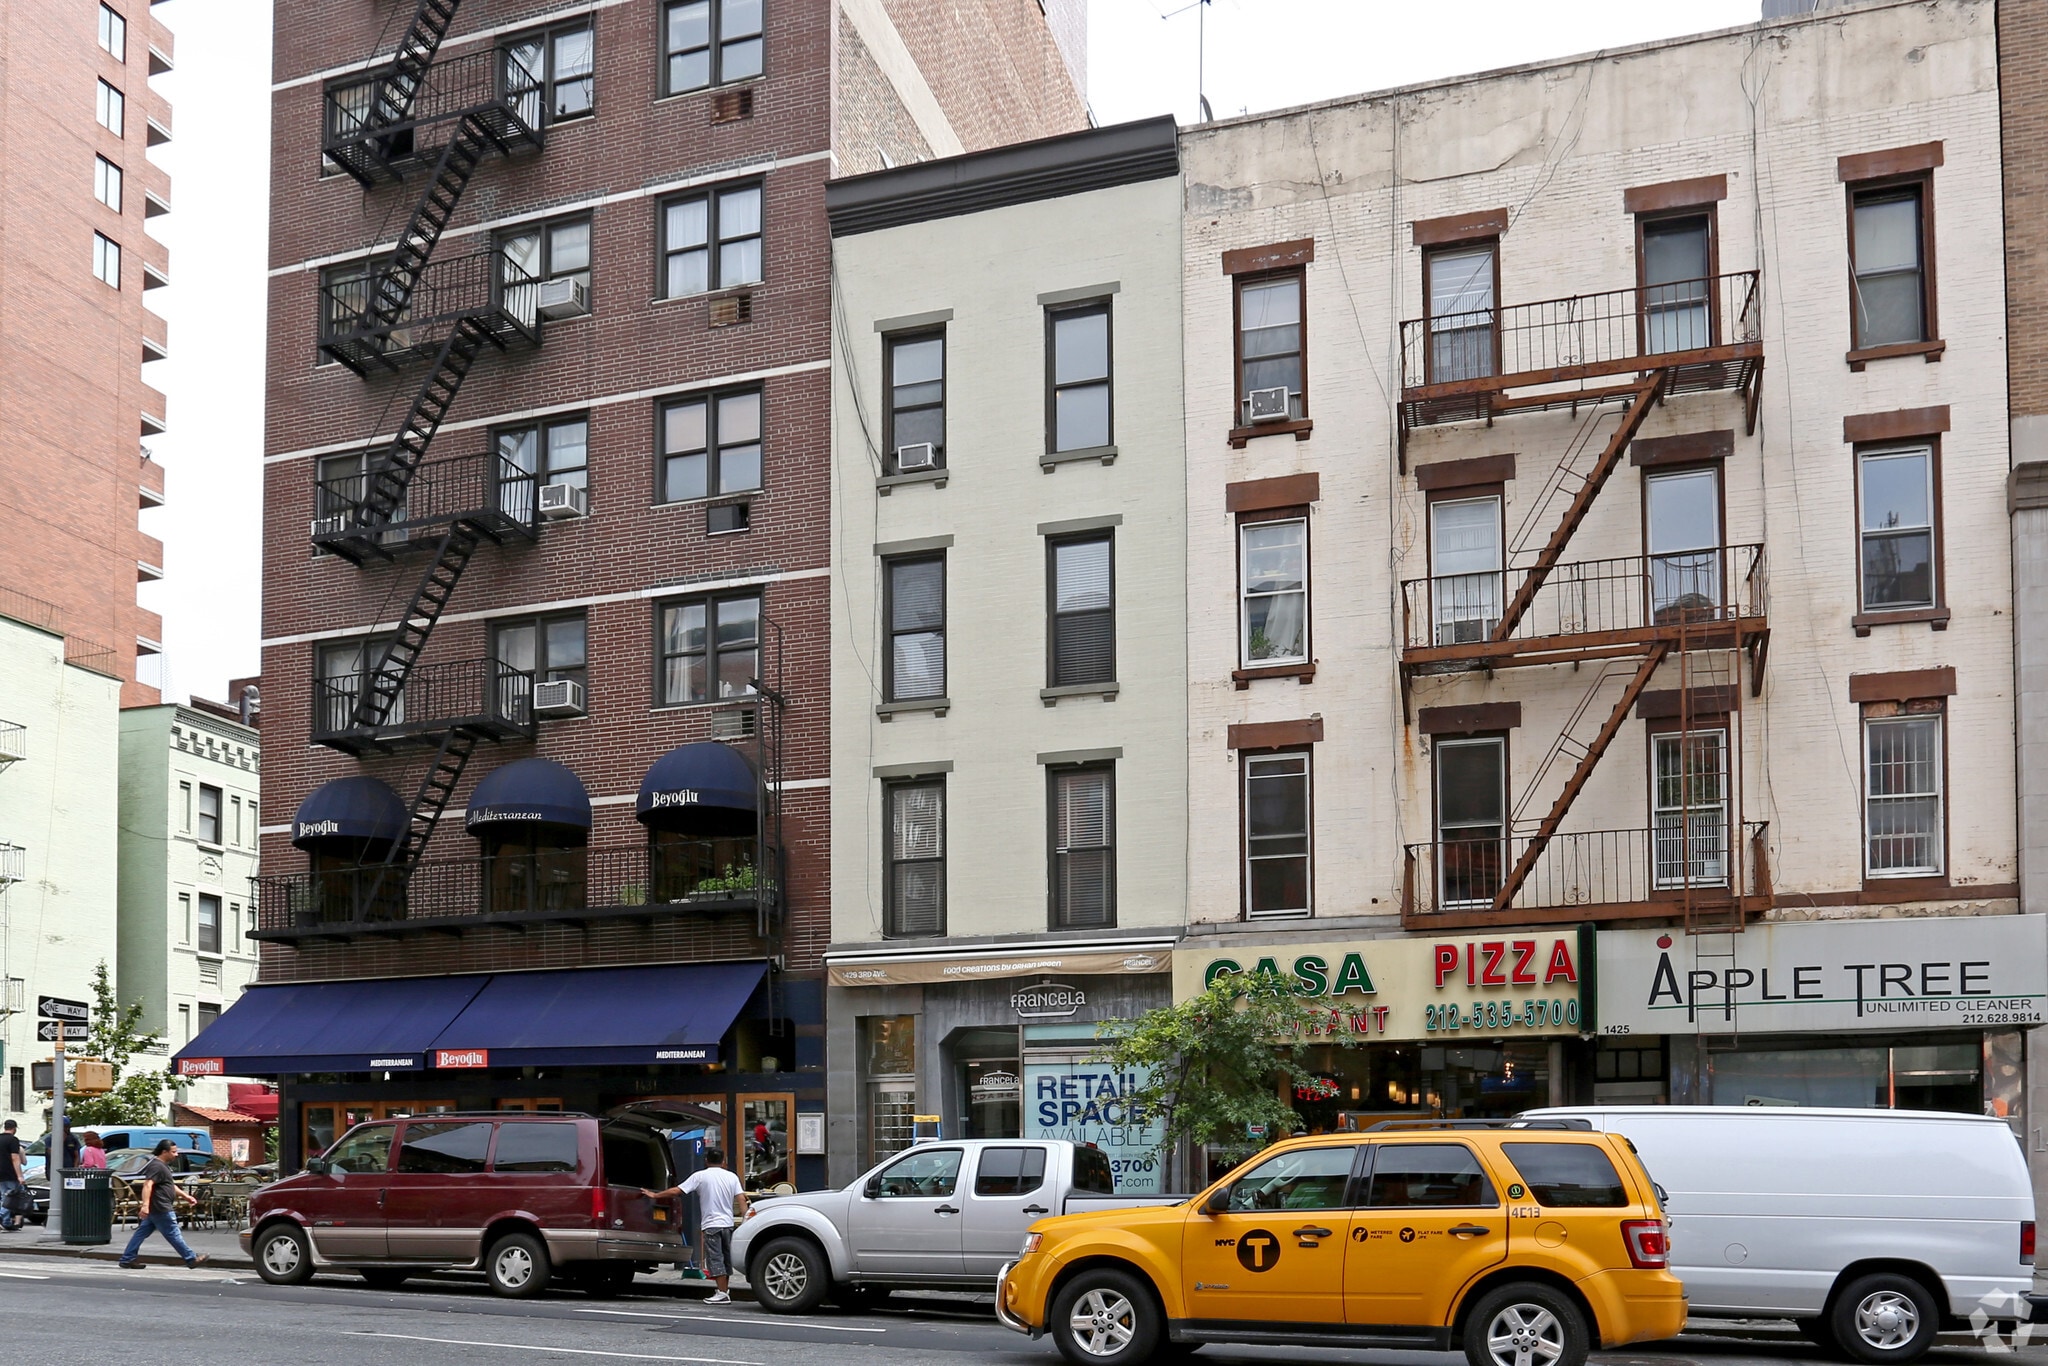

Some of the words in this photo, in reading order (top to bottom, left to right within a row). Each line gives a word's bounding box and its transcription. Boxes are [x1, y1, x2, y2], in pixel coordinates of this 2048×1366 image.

[1434, 939, 1578, 988] PIZZA
[1203, 952, 1377, 1000] CASA
[1648, 952, 1823, 1023] APPLE
[1844, 961, 1991, 1018] TREE
[44, 1002, 60, 1013] ONE
[66, 1006, 82, 1016] WAY
[1866, 1001, 1951, 1013] UNLIMITED
[1956, 999, 2032, 1011] CLEANER
[1425, 998, 1579, 1031] 212-535-5700
[1962, 1012, 2041, 1024] 212.628.9814
[43, 1027, 58, 1036] ONE
[66, 1027, 82, 1036] WAY
[1604, 1024, 1630, 1034] 1425
[656, 1050, 706, 1059] MEDITERRANEAN
[370, 1058, 413, 1067] MEDITERRANEAN
[1038, 1101, 1147, 1127] SPACE
[696, 1140, 702, 1154] P
[1215, 1239, 1236, 1247] NYC
[1246, 1237, 1271, 1268] T
